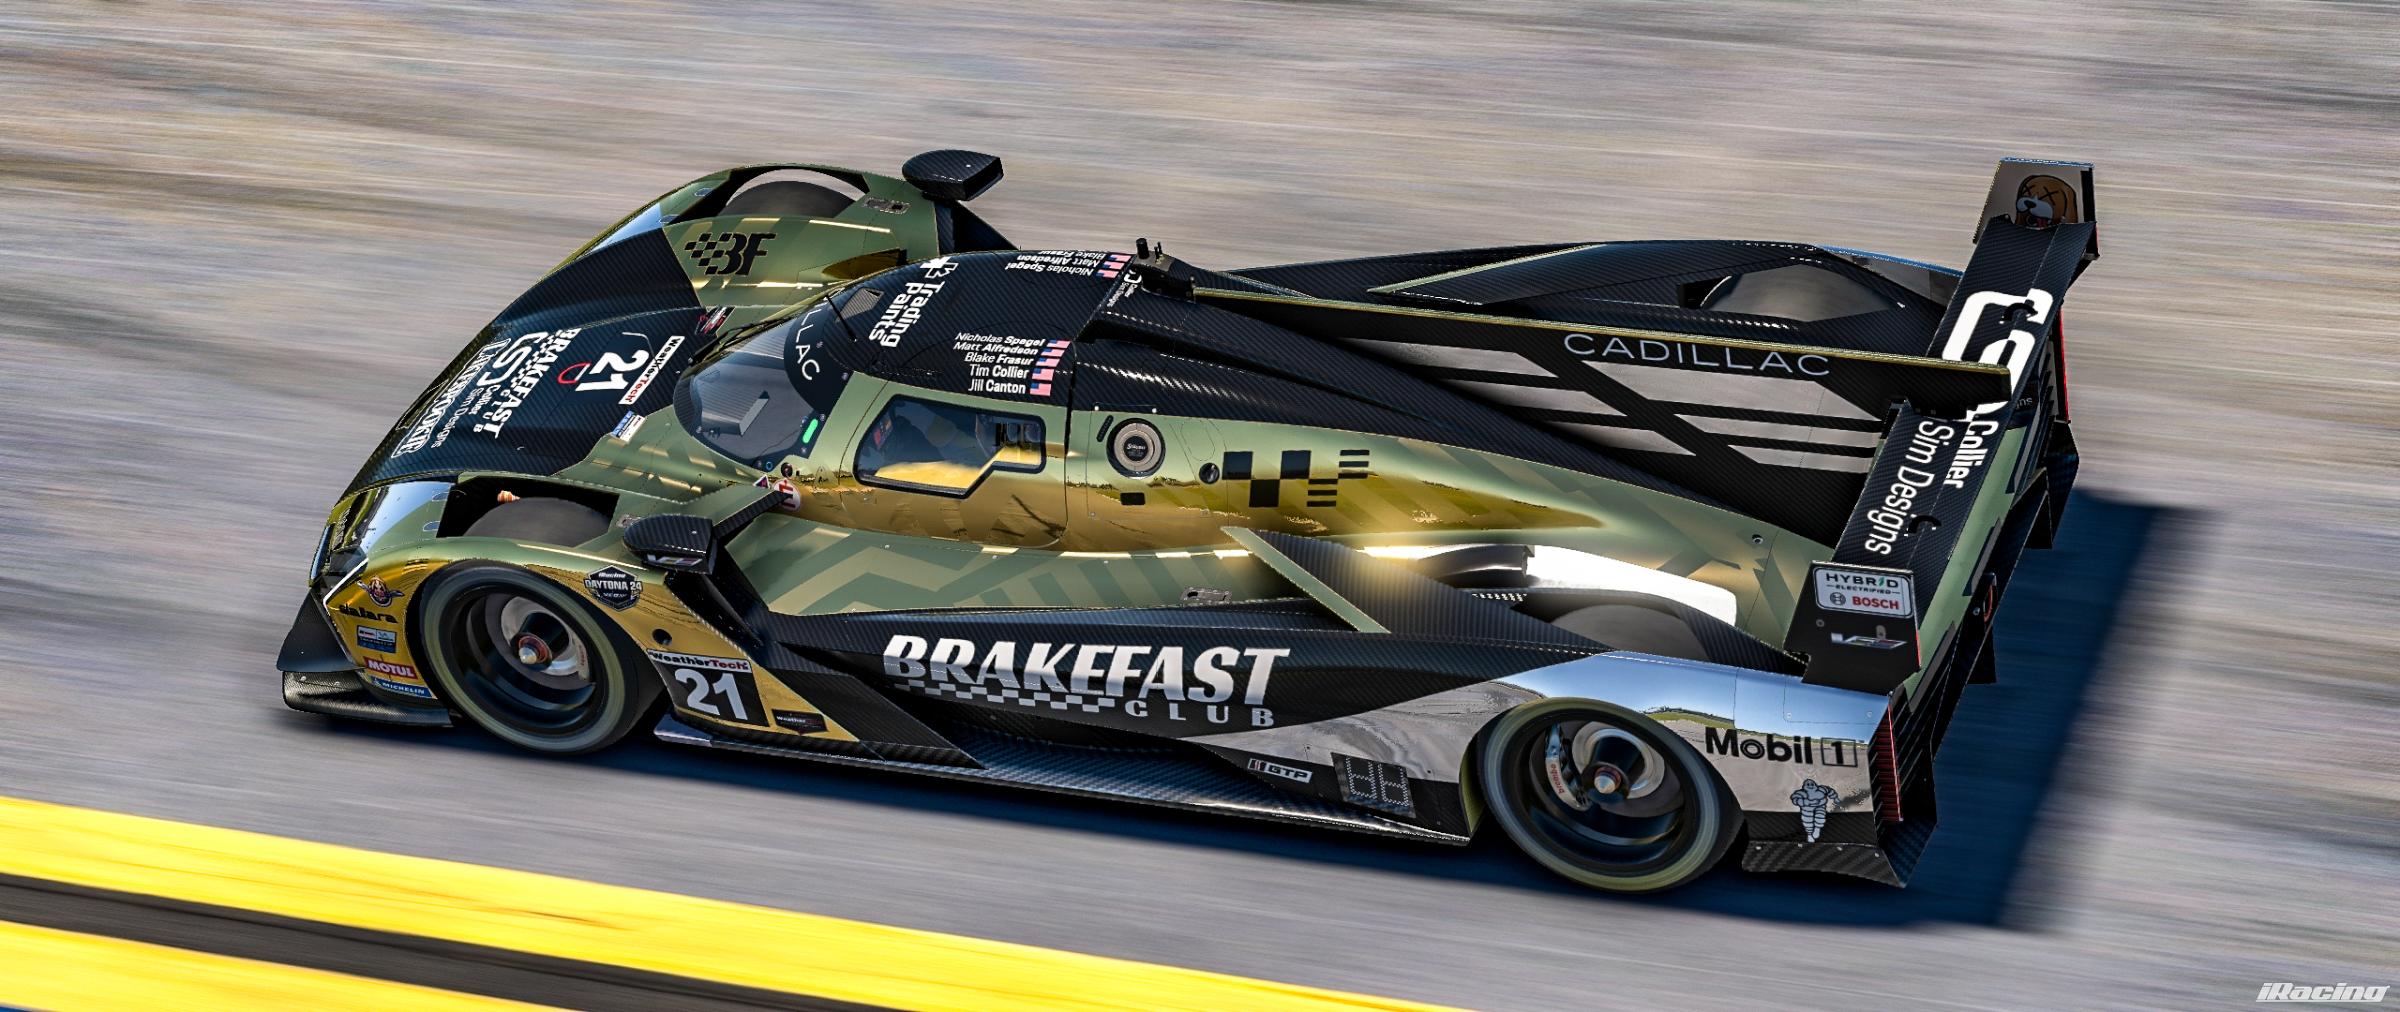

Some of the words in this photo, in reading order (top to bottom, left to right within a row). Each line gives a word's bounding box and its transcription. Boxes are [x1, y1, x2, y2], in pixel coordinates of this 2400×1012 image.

[1047, 265, 1094, 277] Nicholas
[869, 282, 925, 342] Paints
[880, 281, 945, 347] Trading
[953, 341, 982, 350] Matt
[982, 344, 1038, 355] Alfredson
[955, 333, 1002, 343] Nicholas
[1004, 336, 1046, 347] Spegel
[964, 352, 995, 363] Blake
[996, 354, 1034, 366] Frasur
[1564, 333, 1830, 376] CADILLAC
[483, 328, 582, 439] BRAKEFAST
[575, 350, 649, 391] 21
[624, 337, 682, 403] WeatherTech
[970, 364, 989, 376] Tim
[992, 365, 1029, 379] Collier
[968, 379, 984, 392] Jill
[986, 380, 1026, 394] Canton
[473, 389, 511, 432] CLUB
[1906, 420, 1955, 464] Sim
[1943, 420, 1999, 489] Collier
[1864, 465, 1935, 555] Designs
[585, 579, 628, 590] DAYTONA
[630, 581, 643, 591] 24
[1835, 585, 1891, 594] ELECTRIFIED
[1852, 596, 1899, 610] BOSCH
[368, 660, 415, 677] MOTUL
[652, 651, 749, 671] WeatherTech
[883, 634, 1291, 705] BRAKEFAST
[382, 682, 425, 695] MICHELIN
[674, 668, 748, 720] 21
[1125, 700, 1274, 727] CLUB
[1704, 727, 1813, 765] Mobil
[1268, 765, 1309, 780] GTP
